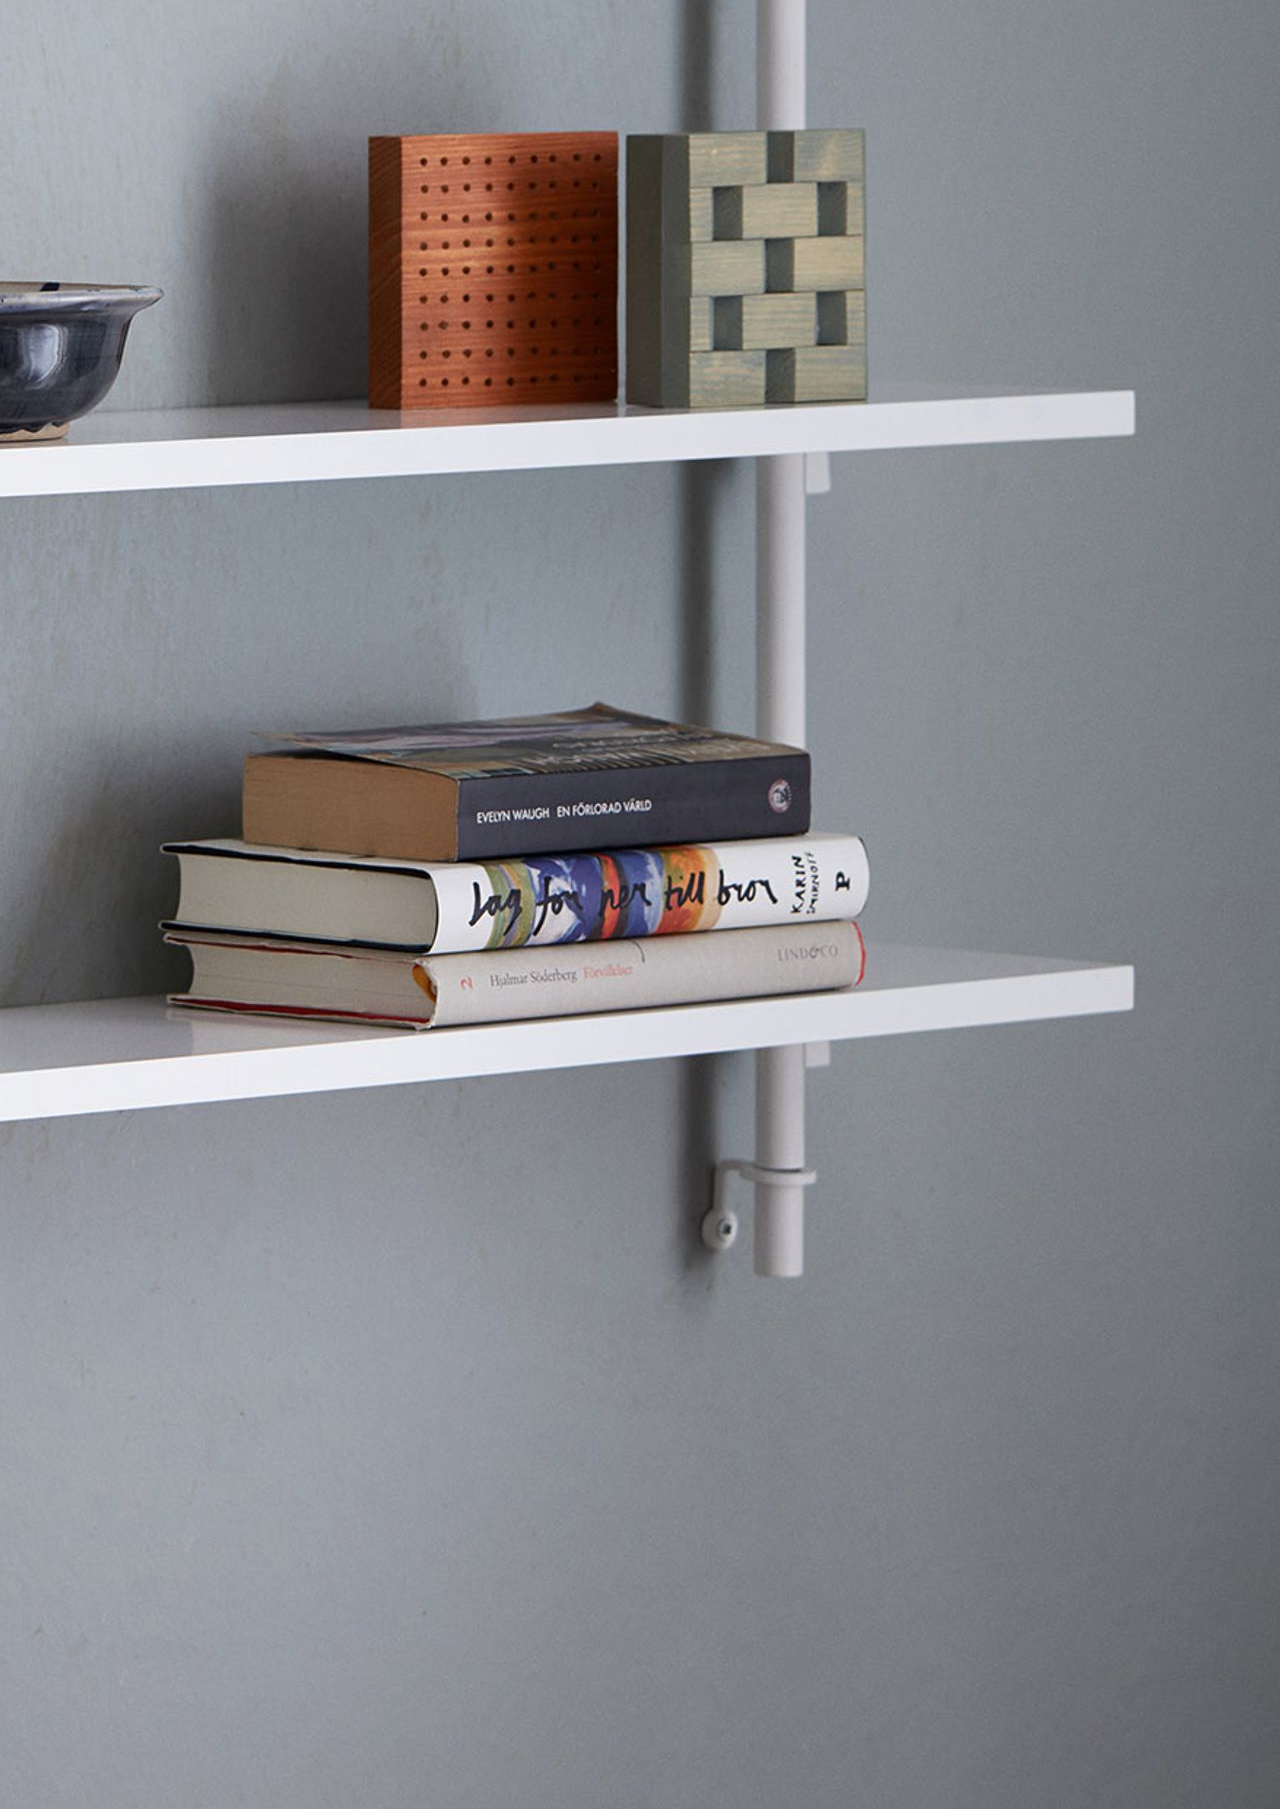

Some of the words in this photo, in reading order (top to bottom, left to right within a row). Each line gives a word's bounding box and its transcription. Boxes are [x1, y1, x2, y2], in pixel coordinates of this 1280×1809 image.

[476, 810, 511, 824] EVELYN
[513, 807, 550, 820] WAUGH
[556, 805, 570, 818] EN
[572, 801, 622, 817] FÖRLORAD
[623, 797, 653, 813] VÄRLD
[663, 872, 704, 913] till
[717, 869, 779, 907] bror
[789, 854, 805, 914] KARIN
[805, 851, 818, 916] SMIRNOFF
[835, 871, 851, 891] P
[777, 945, 839, 962] LIND&CO
[459, 976, 474, 991] 2
[489, 973, 528, 989] Hjalmar
[530, 968, 578, 984] Söderberg
[582, 963, 634, 980] Förvillelser
